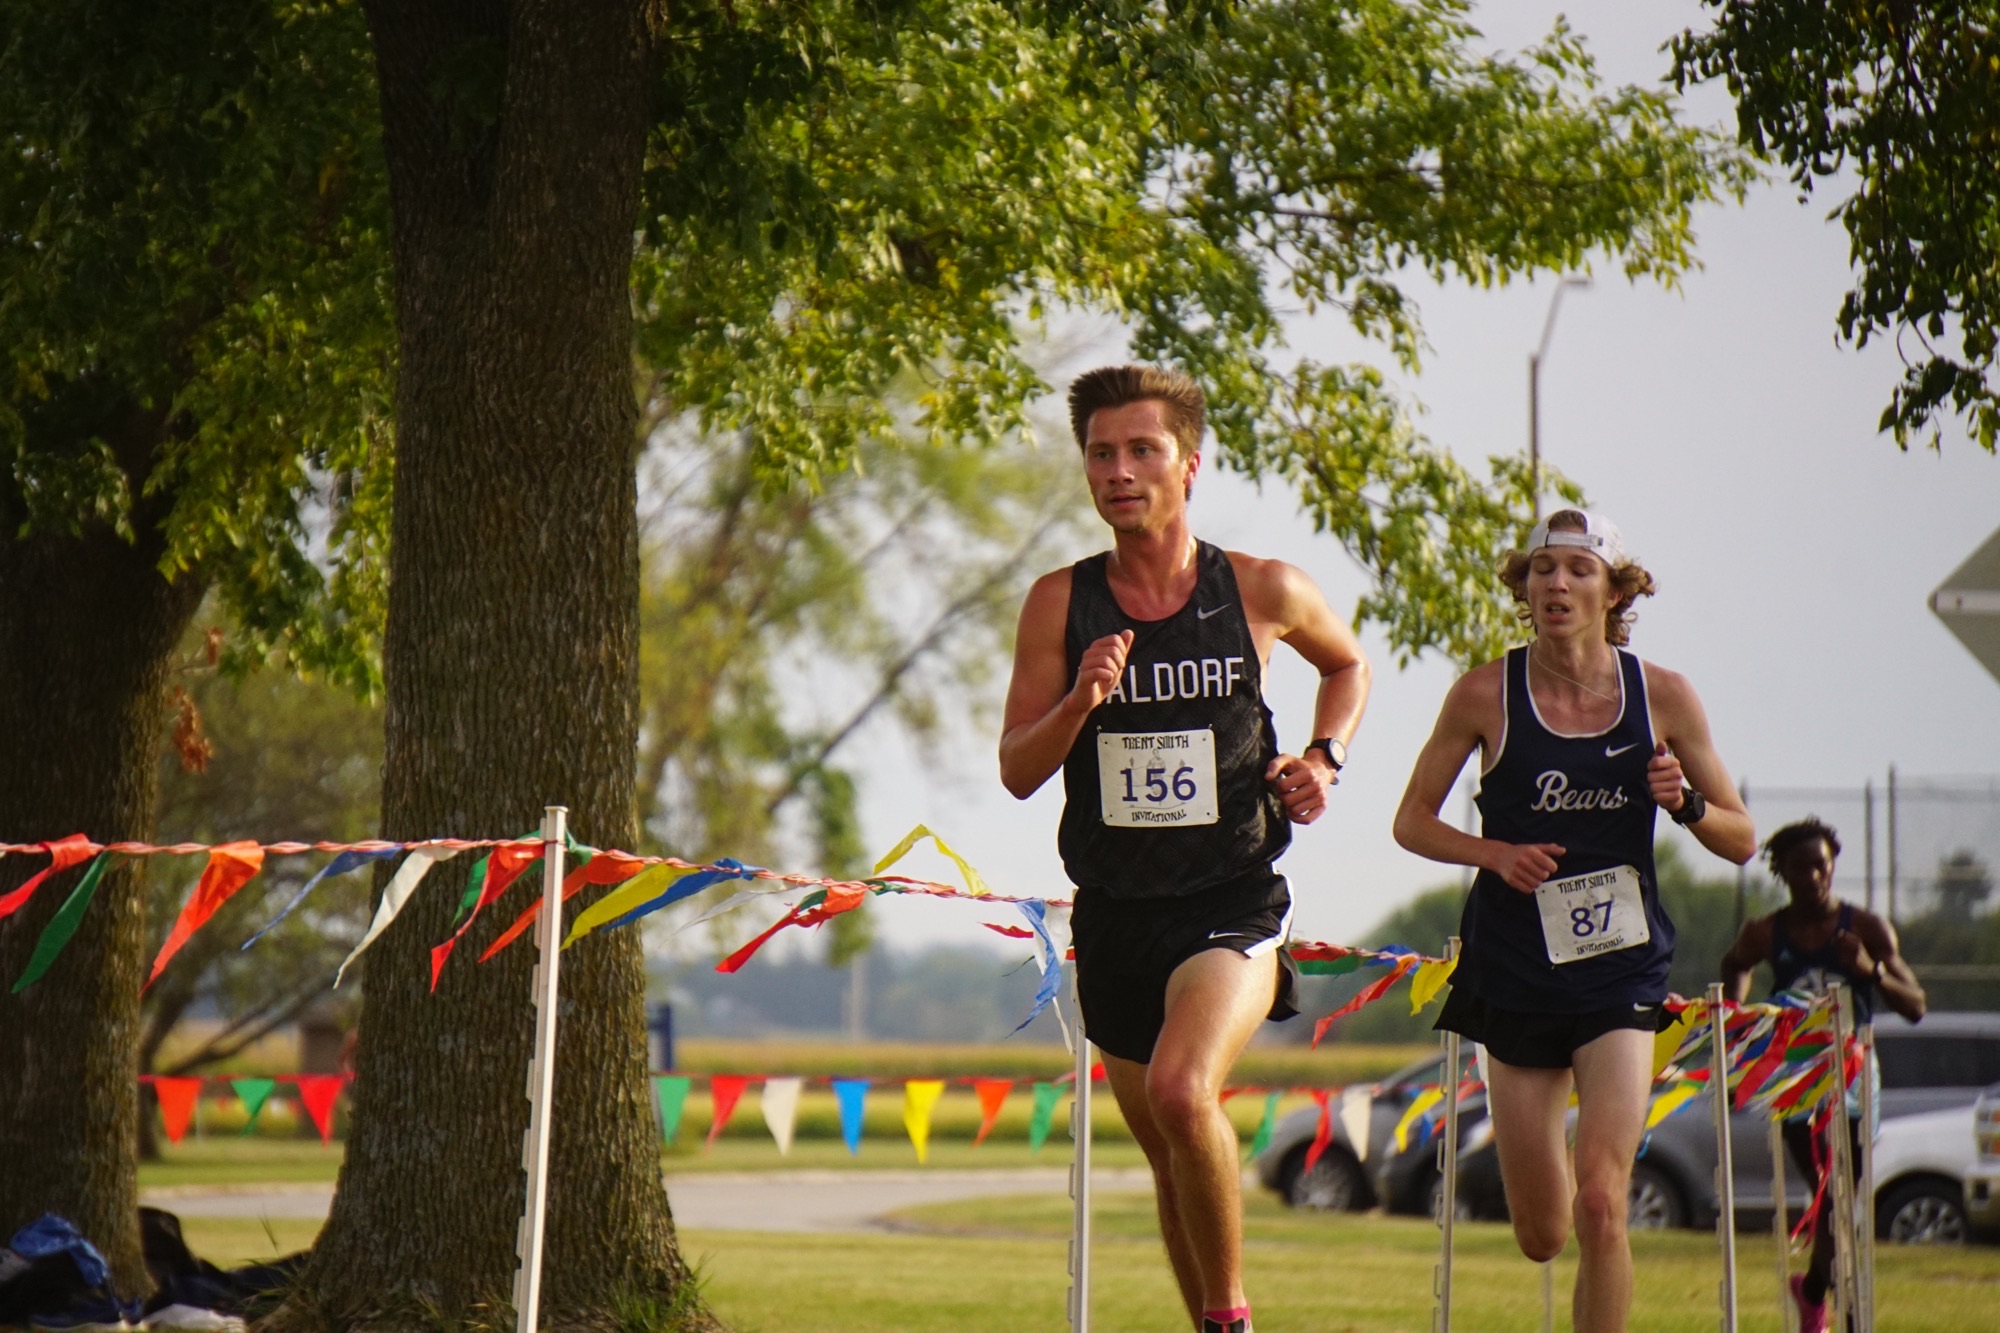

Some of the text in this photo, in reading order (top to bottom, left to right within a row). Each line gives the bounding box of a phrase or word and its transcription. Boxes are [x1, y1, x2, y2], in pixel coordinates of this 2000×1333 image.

[1106, 657, 1244, 704] ALDORF
[1122, 735, 1189, 750] TRENT SMITH
[1120, 766, 1197, 802] 156
[1531, 769, 1628, 812] Bears
[1131, 809, 1187, 822] INVITATIONAL
[1557, 878, 1586, 894] TRENT
[1570, 900, 1613, 937] 87
[1576, 935, 1624, 955] INVITATIONAL
